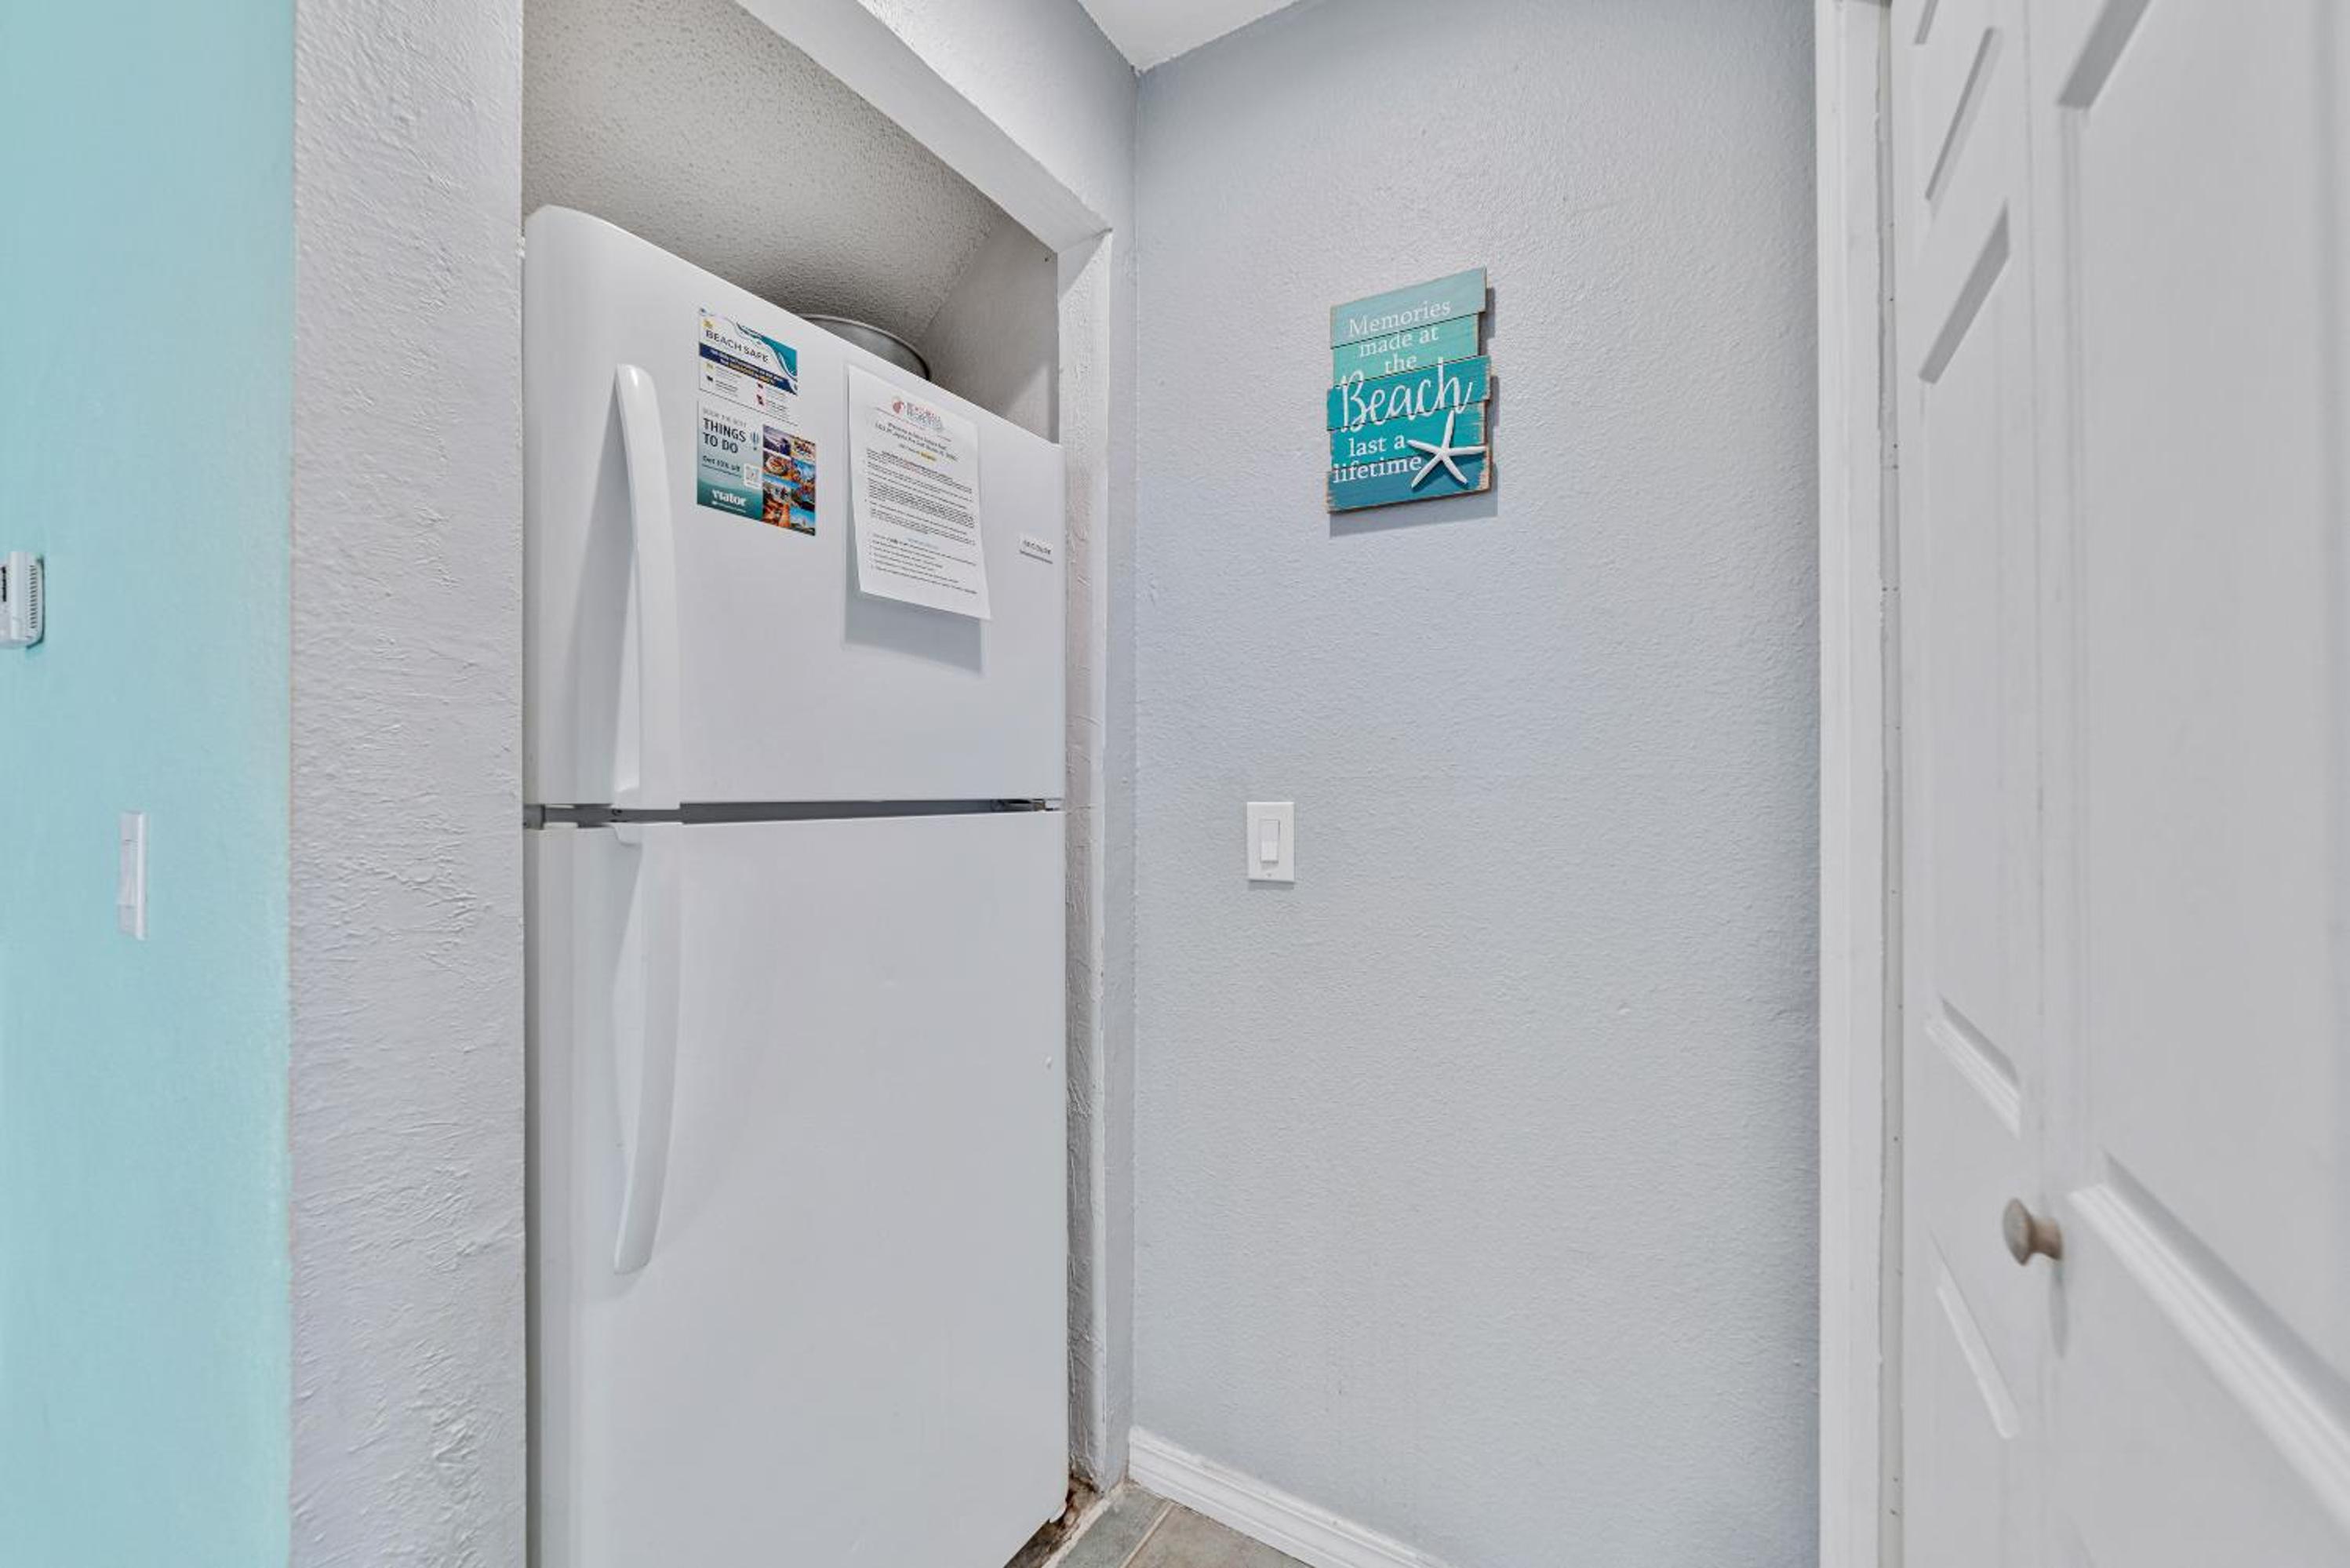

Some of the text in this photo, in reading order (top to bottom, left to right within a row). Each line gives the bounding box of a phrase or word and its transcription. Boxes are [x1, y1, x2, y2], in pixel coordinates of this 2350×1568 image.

[1348, 300, 1451, 338] Memories
[706, 329, 769, 362] BEACH SAFE
[1359, 326, 1439, 358] made at
[1384, 353, 1417, 374] the
[1334, 356, 1473, 432] Beach
[703, 417, 747, 442] THINGS
[703, 431, 738, 454] TO DO
[1348, 435, 1406, 457] last a
[1333, 455, 1423, 483] lifetime
[711, 488, 747, 507] viator
